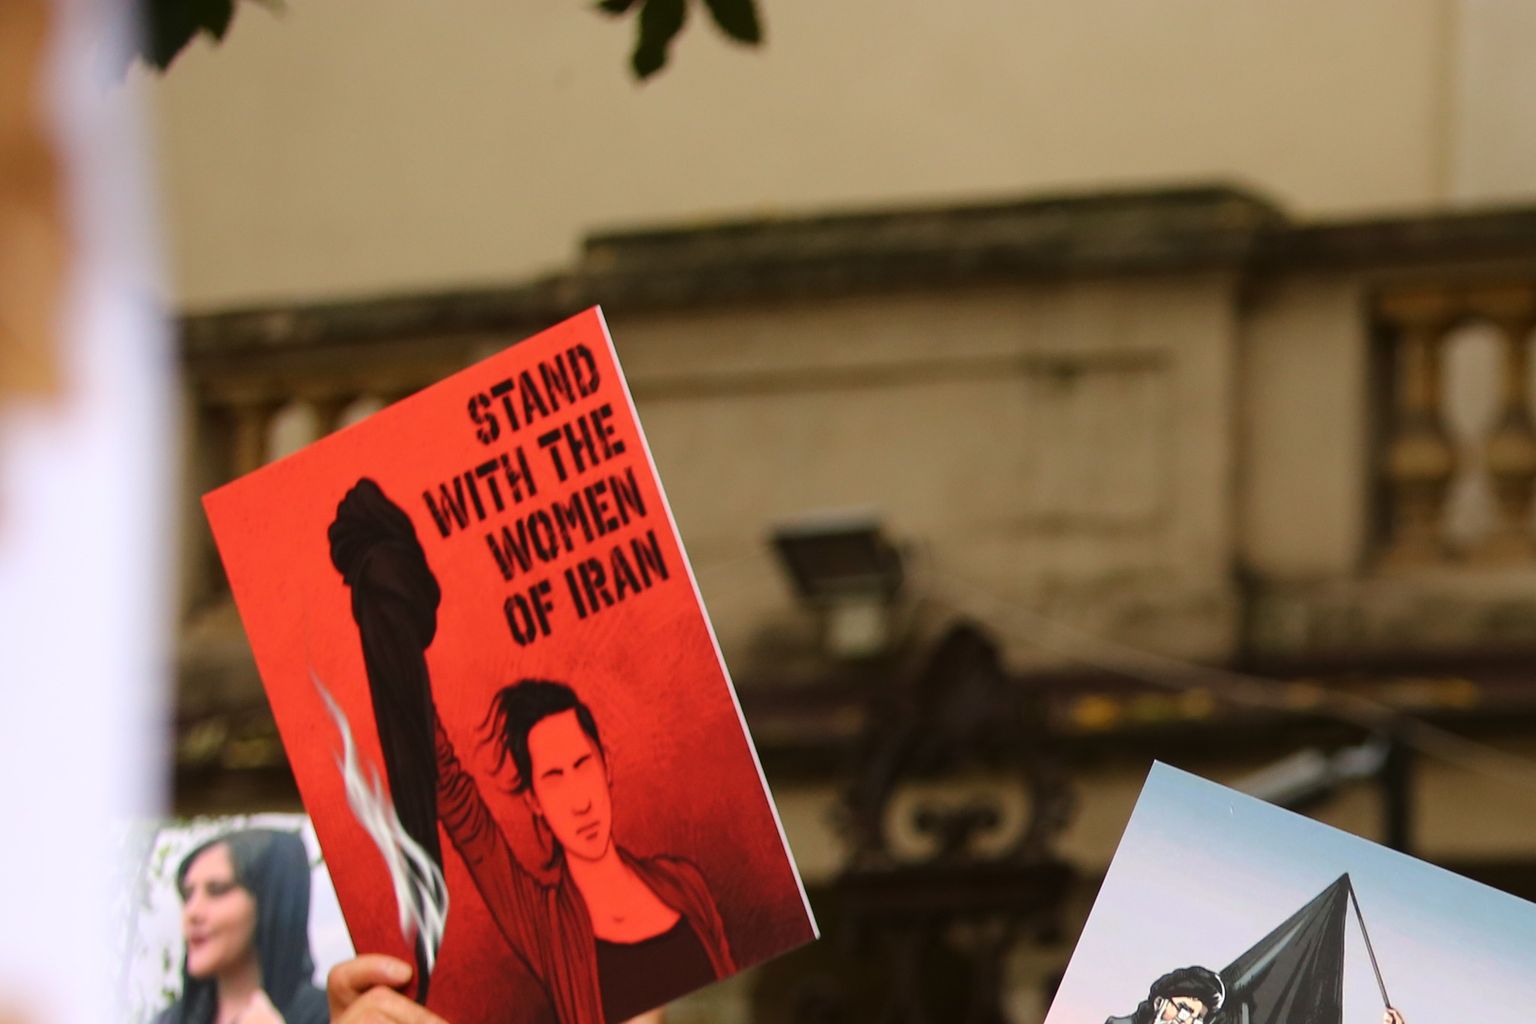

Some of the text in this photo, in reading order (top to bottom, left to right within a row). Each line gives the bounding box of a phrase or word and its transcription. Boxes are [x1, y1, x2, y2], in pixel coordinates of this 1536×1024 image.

[468, 344, 600, 445] STAND
[422, 403, 626, 538] WITH THE
[486, 466, 647, 582] WOMEN
[503, 529, 669, 647] OF IRAN
